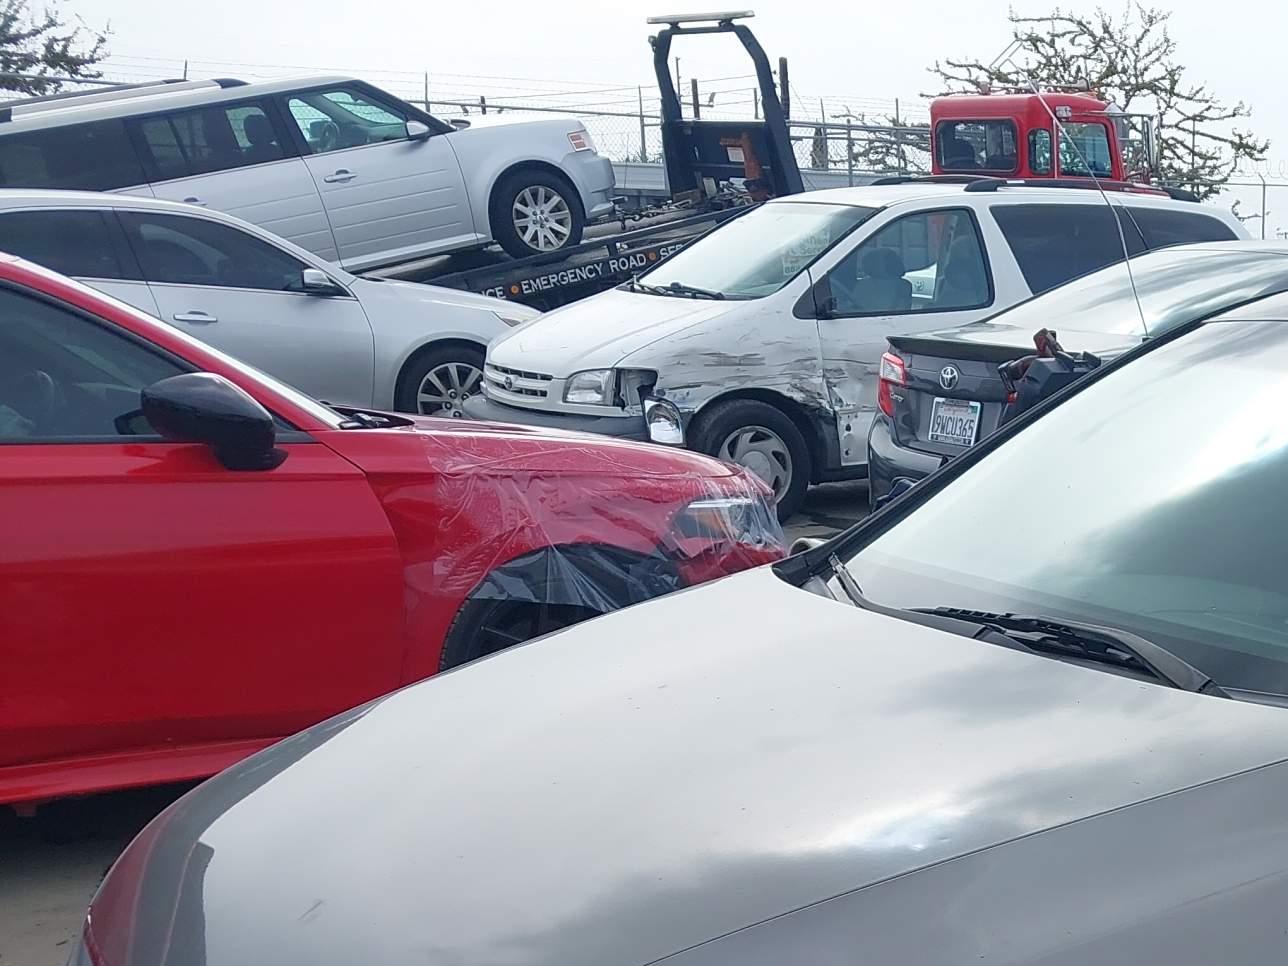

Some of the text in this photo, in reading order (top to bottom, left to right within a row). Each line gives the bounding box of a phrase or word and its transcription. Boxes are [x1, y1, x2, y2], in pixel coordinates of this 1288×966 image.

[521, 262, 604, 294] EMERGENCY
[609, 253, 647, 273] ROAD
[934, 414, 975, 439] 9WCU365
